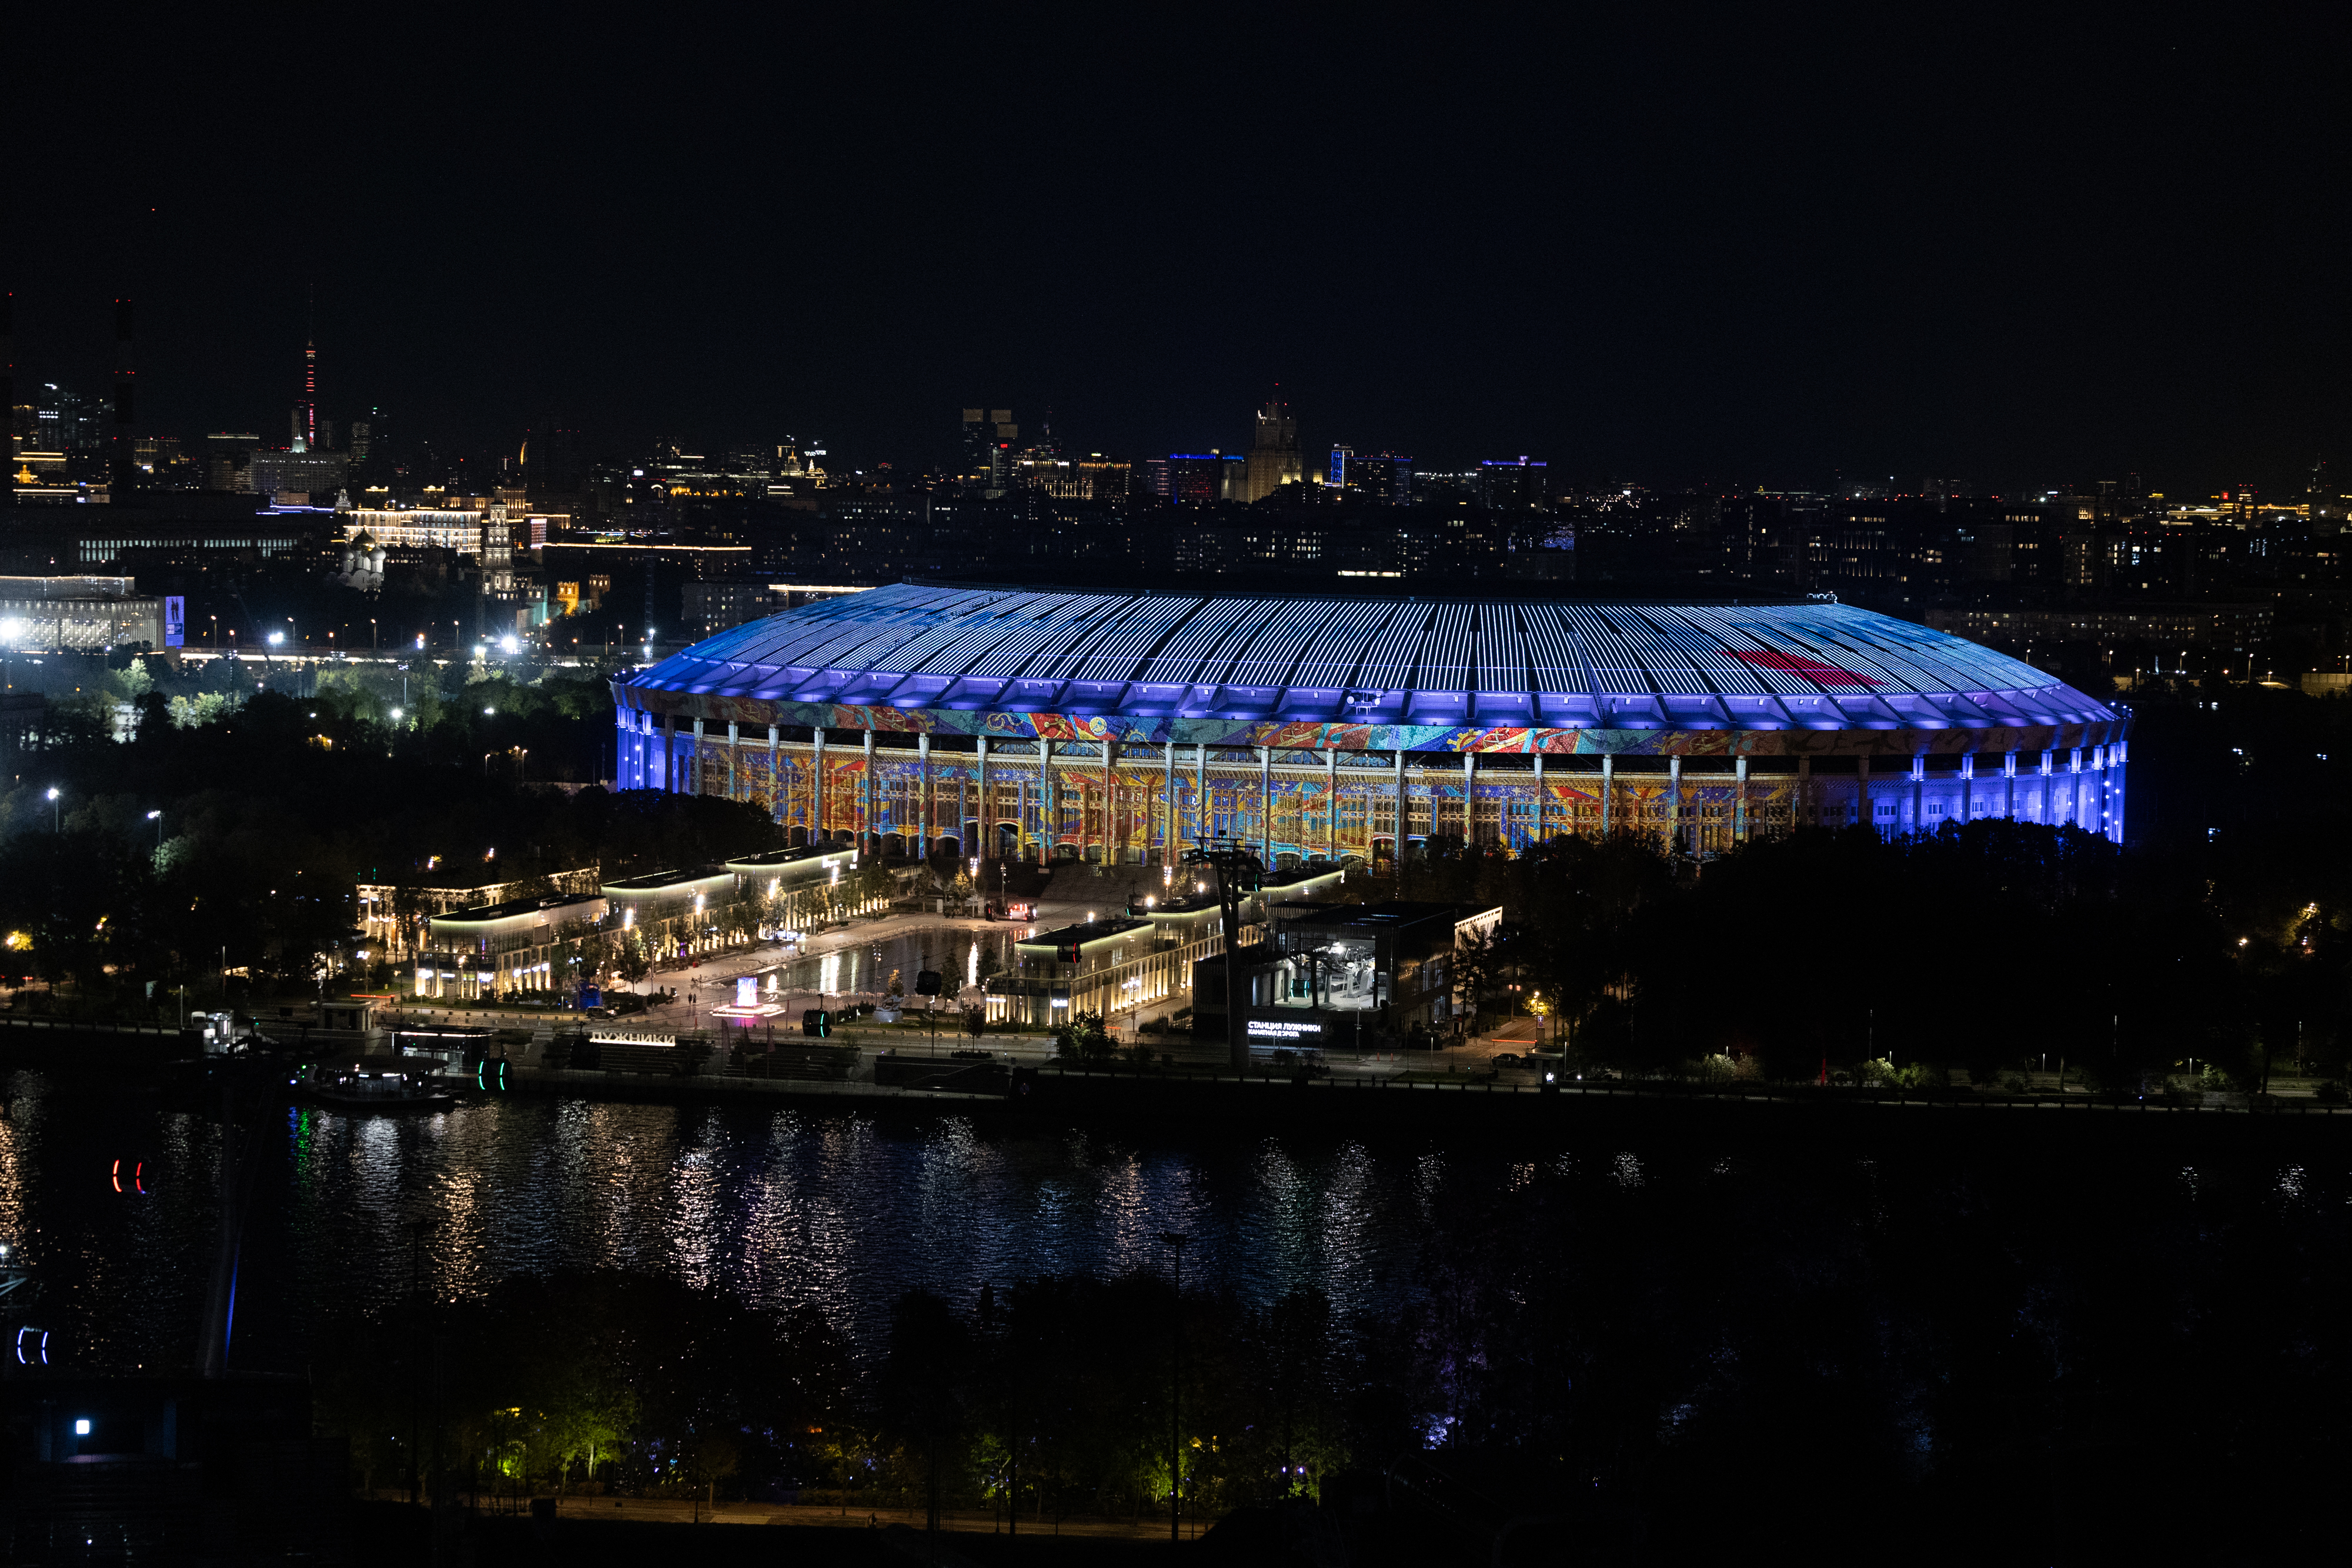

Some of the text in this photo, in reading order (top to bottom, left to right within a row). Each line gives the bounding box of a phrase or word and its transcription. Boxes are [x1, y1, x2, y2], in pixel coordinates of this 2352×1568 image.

[1248, 1021, 1321, 1032] СТАНЦИЯ ЛУЖНИКИ
[592, 1032, 676, 1045] ЛУЖНИКИ
